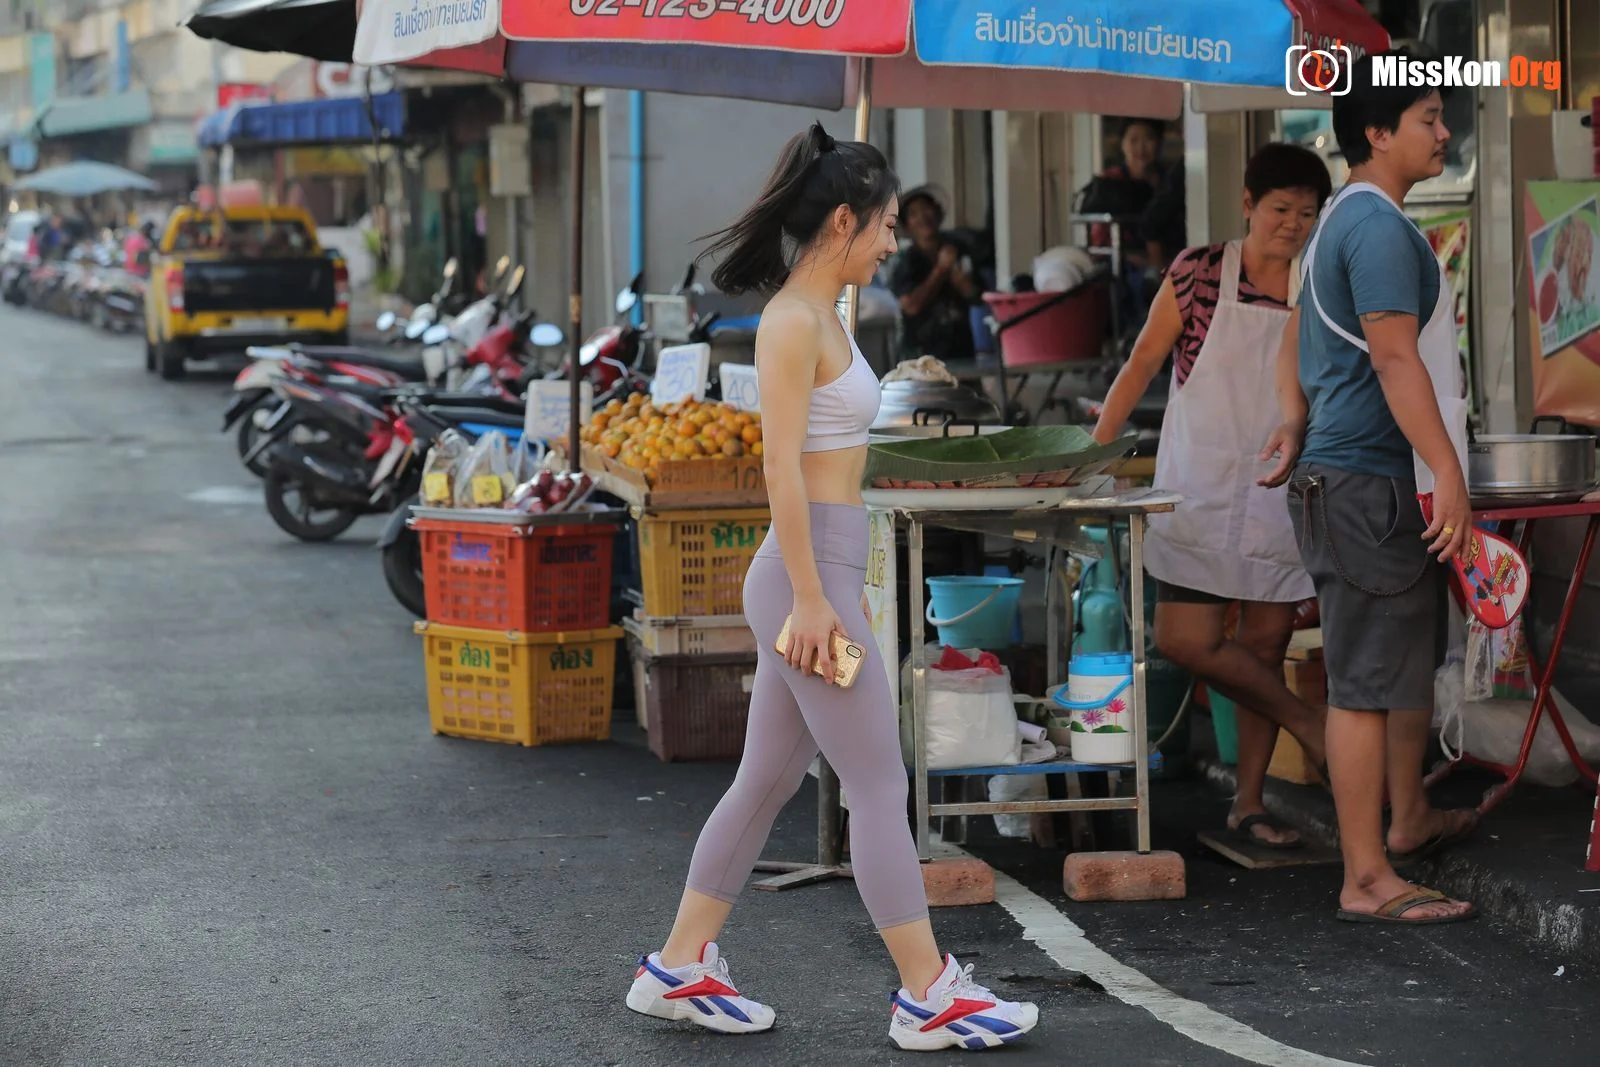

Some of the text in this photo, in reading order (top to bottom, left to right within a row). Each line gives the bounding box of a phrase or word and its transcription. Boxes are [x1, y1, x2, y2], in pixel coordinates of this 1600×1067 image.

[975, 8, 1232, 64] สินเชื่อจำนำทะเบียนรถ
[726, 379, 760, 413] 40
